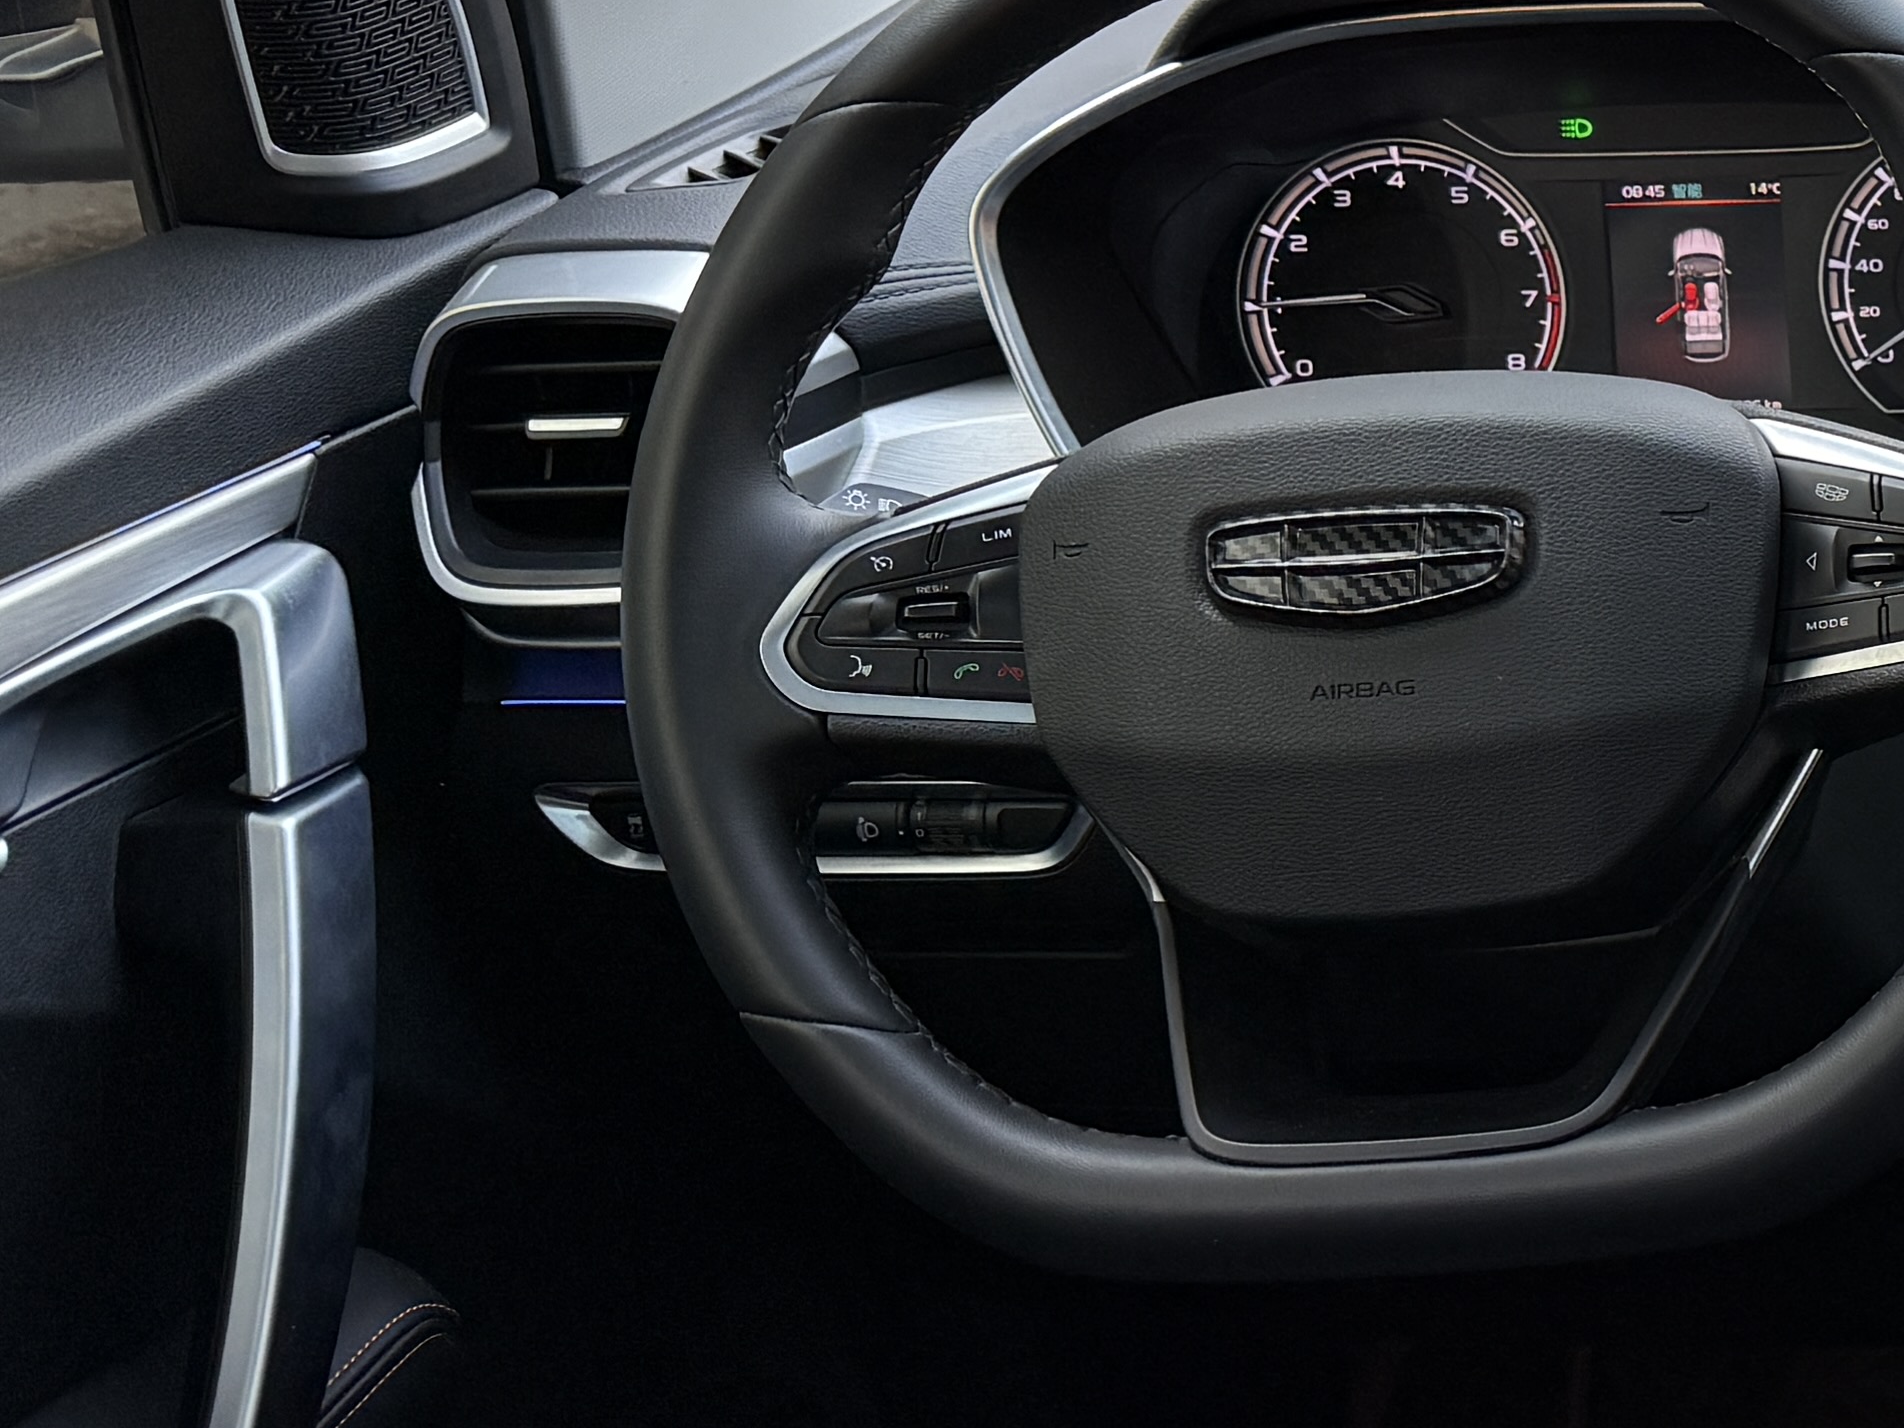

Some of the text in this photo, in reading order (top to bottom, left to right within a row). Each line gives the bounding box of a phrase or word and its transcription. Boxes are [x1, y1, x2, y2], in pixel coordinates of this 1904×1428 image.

[1386, 171, 1405, 188] 4
[1333, 190, 1351, 207] 3
[1450, 187, 1469, 204] 5
[1672, 183, 1703, 199] 智能
[1867, 219, 1889, 230] 60
[1289, 235, 1308, 252] 2
[1500, 229, 1519, 247] 6
[1855, 258, 1883, 272] 40
[1521, 290, 1538, 307] 7
[1859, 305, 1880, 318] 20
[1295, 360, 1313, 376] 0
[1507, 353, 1526, 371] 8
[982, 528, 1012, 542] LIM
[1806, 617, 1849, 631] MODE
[1310, 679, 1416, 701] AIRBAG
